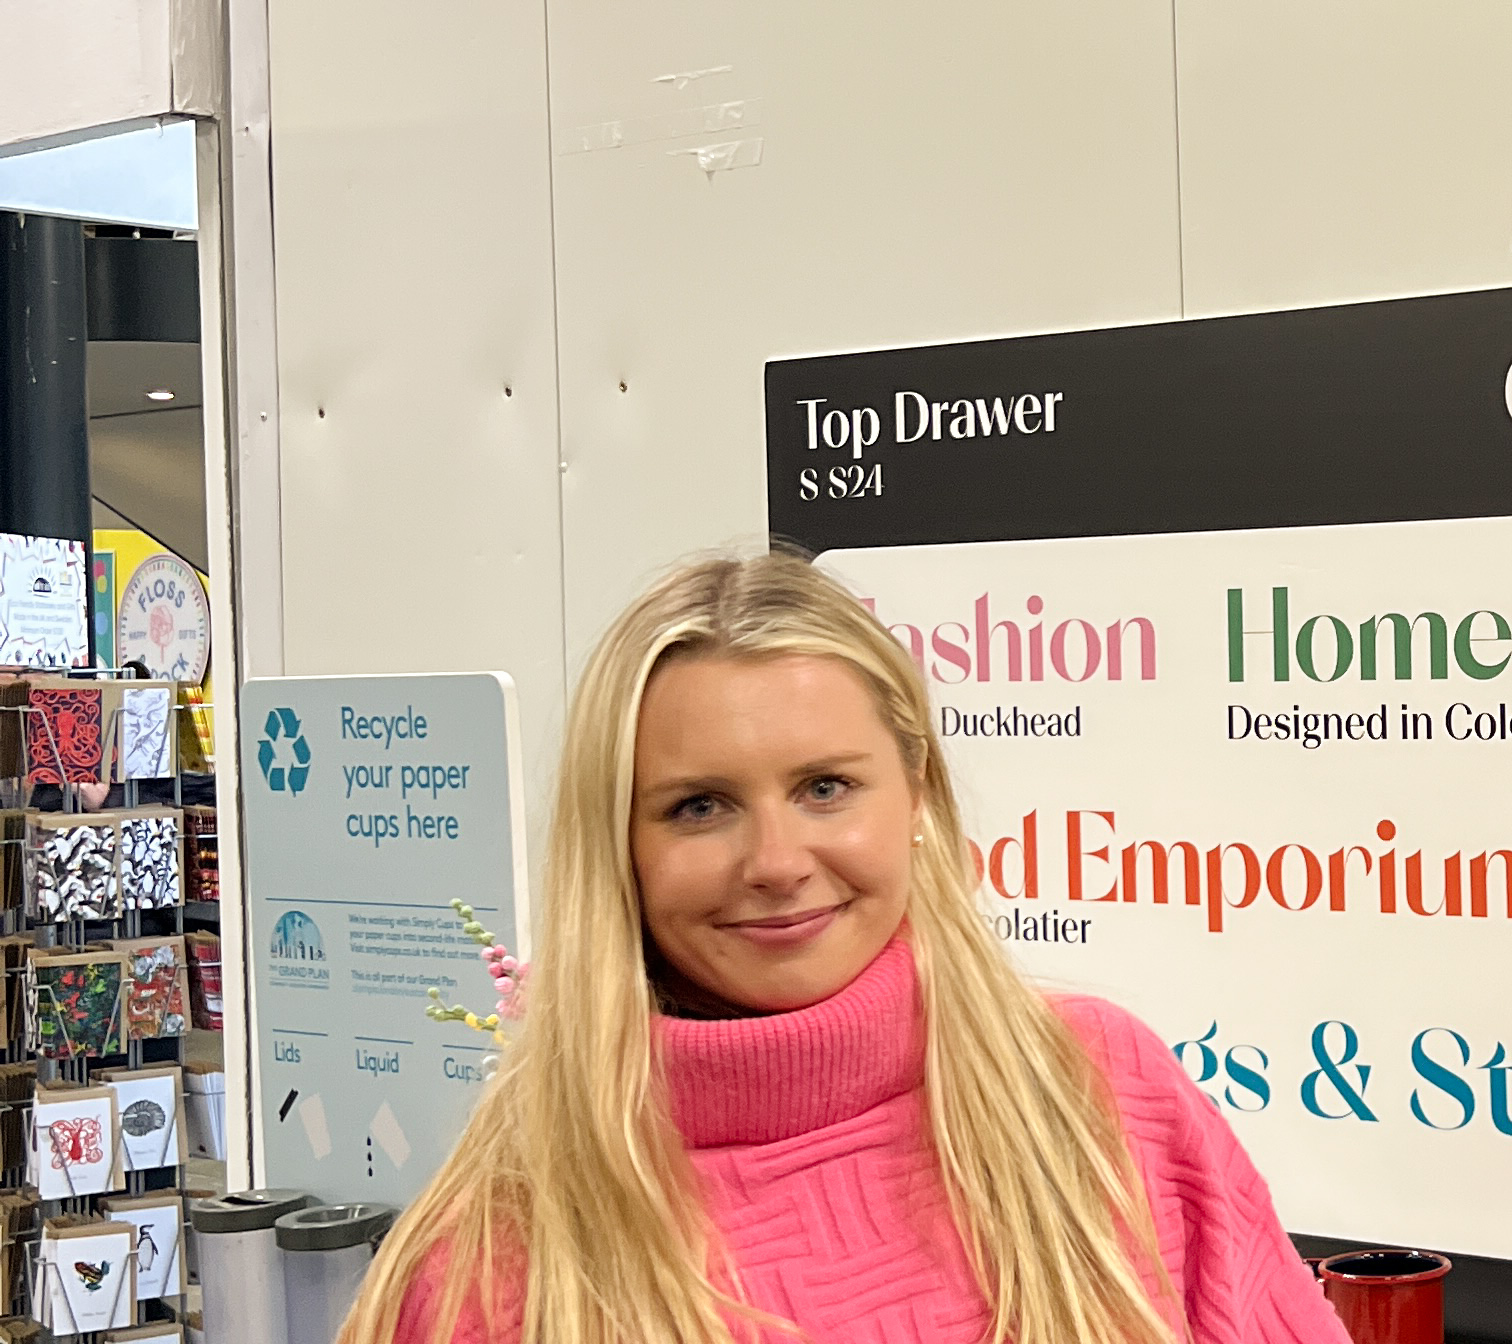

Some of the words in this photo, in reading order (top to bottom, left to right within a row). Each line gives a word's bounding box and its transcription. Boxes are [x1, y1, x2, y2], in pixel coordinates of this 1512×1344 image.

[796, 398, 880, 459] Top
[895, 391, 1064, 443] Drawer
[138, 579, 186, 613] FLOSS
[860, 592, 1156, 684] ashion
[1227, 586, 1512, 683] Home
[341, 705, 428, 749] Recycle
[942, 705, 1082, 738] Duckhead
[1227, 704, 1387, 749] Designed
[1401, 706, 1433, 741] in
[343, 765, 392, 798] your
[402, 765, 470, 799] paper
[347, 814, 399, 848] cups
[407, 805, 459, 839] here
[274, 1040, 301, 1063] Lids
[356, 1049, 399, 1077] Liquid
[1301, 1020, 1379, 1122] &
